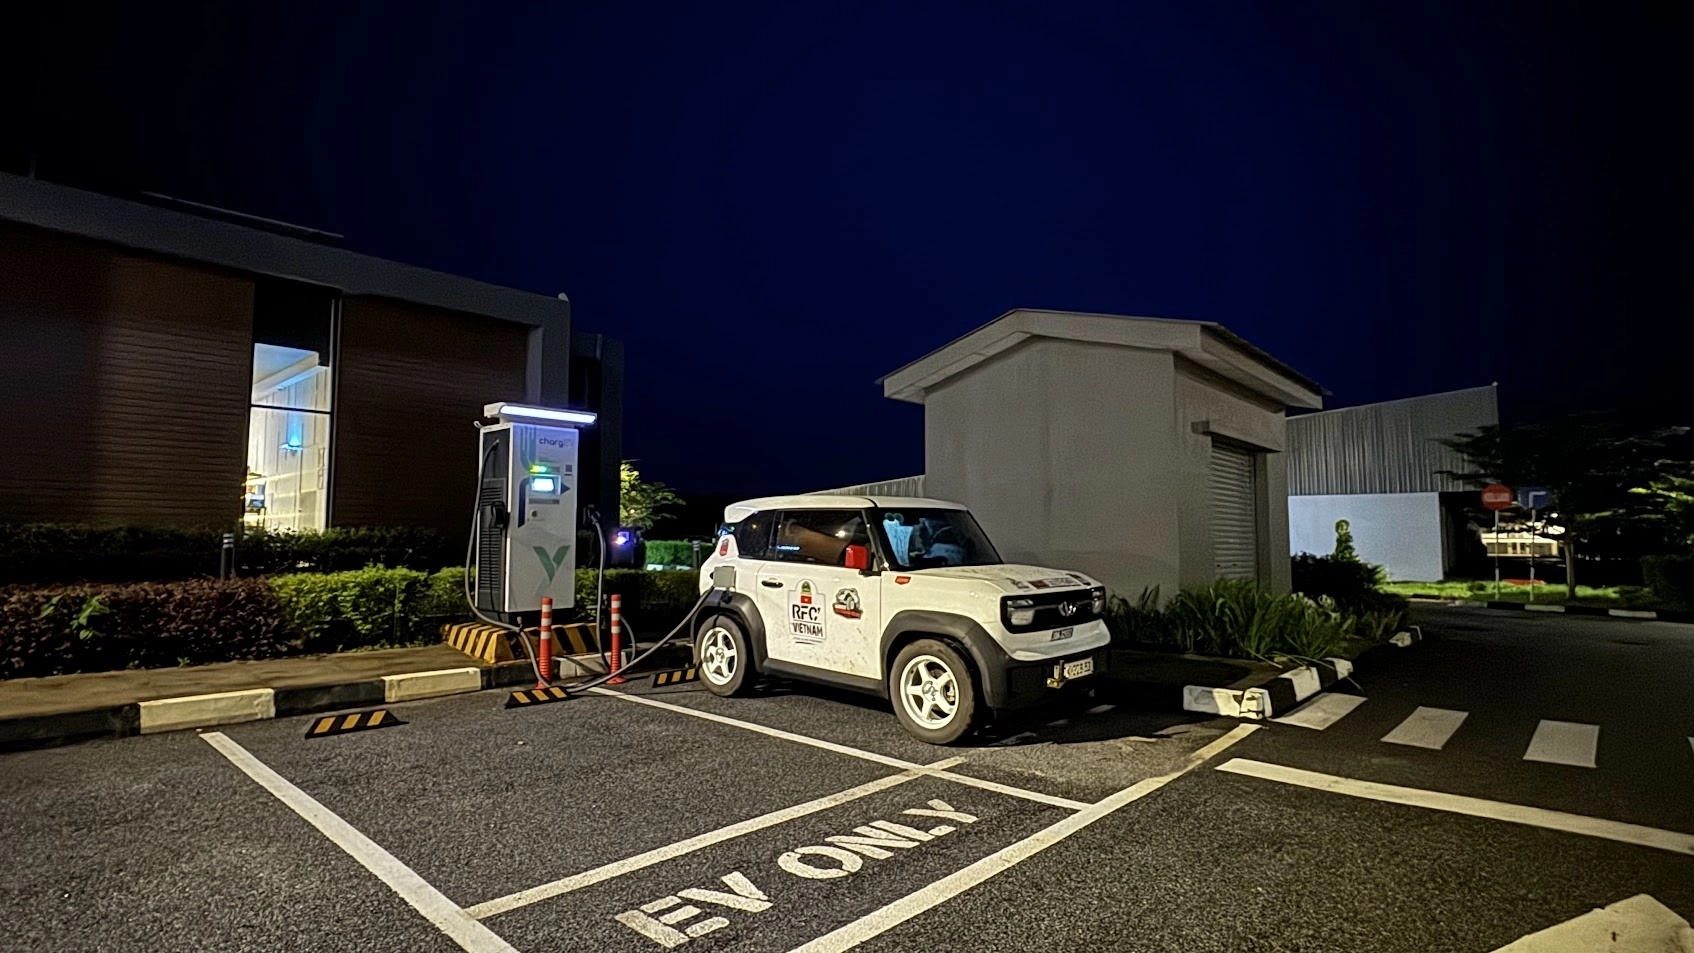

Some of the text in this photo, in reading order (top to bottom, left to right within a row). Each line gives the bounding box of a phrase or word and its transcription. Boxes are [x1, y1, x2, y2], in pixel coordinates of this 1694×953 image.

[792, 622, 824, 637] VIETNAM
[614, 798, 979, 948] EV ONLY
